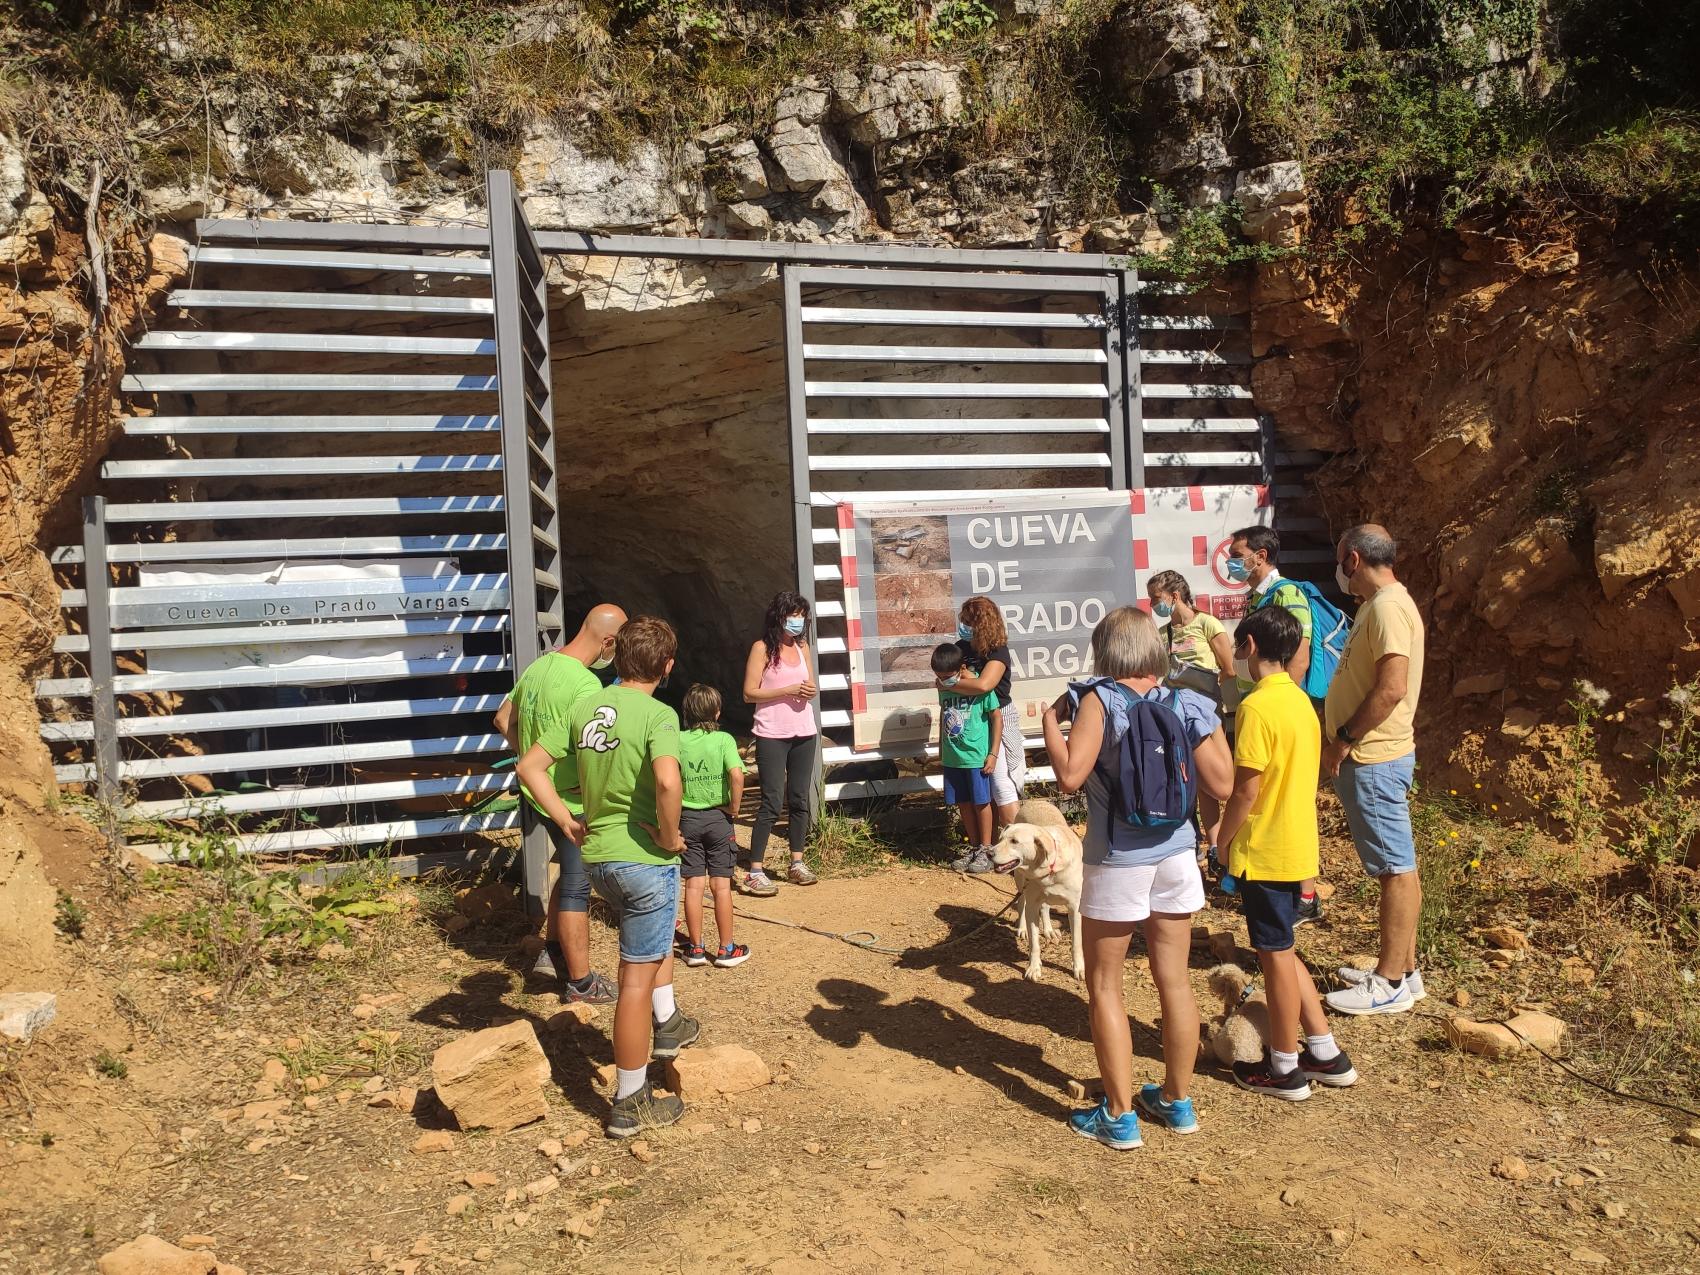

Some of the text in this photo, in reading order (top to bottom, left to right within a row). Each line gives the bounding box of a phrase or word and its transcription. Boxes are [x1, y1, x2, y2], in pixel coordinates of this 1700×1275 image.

[967, 512, 1097, 550] CUEVA
[970, 560, 1022, 594] DE
[167, 596, 470, 620] Cueva De Prado Vargas
[1000, 598, 1106, 634] RADO
[1009, 642, 1096, 679] ARGA
[682, 773, 725, 783] oluntariad
